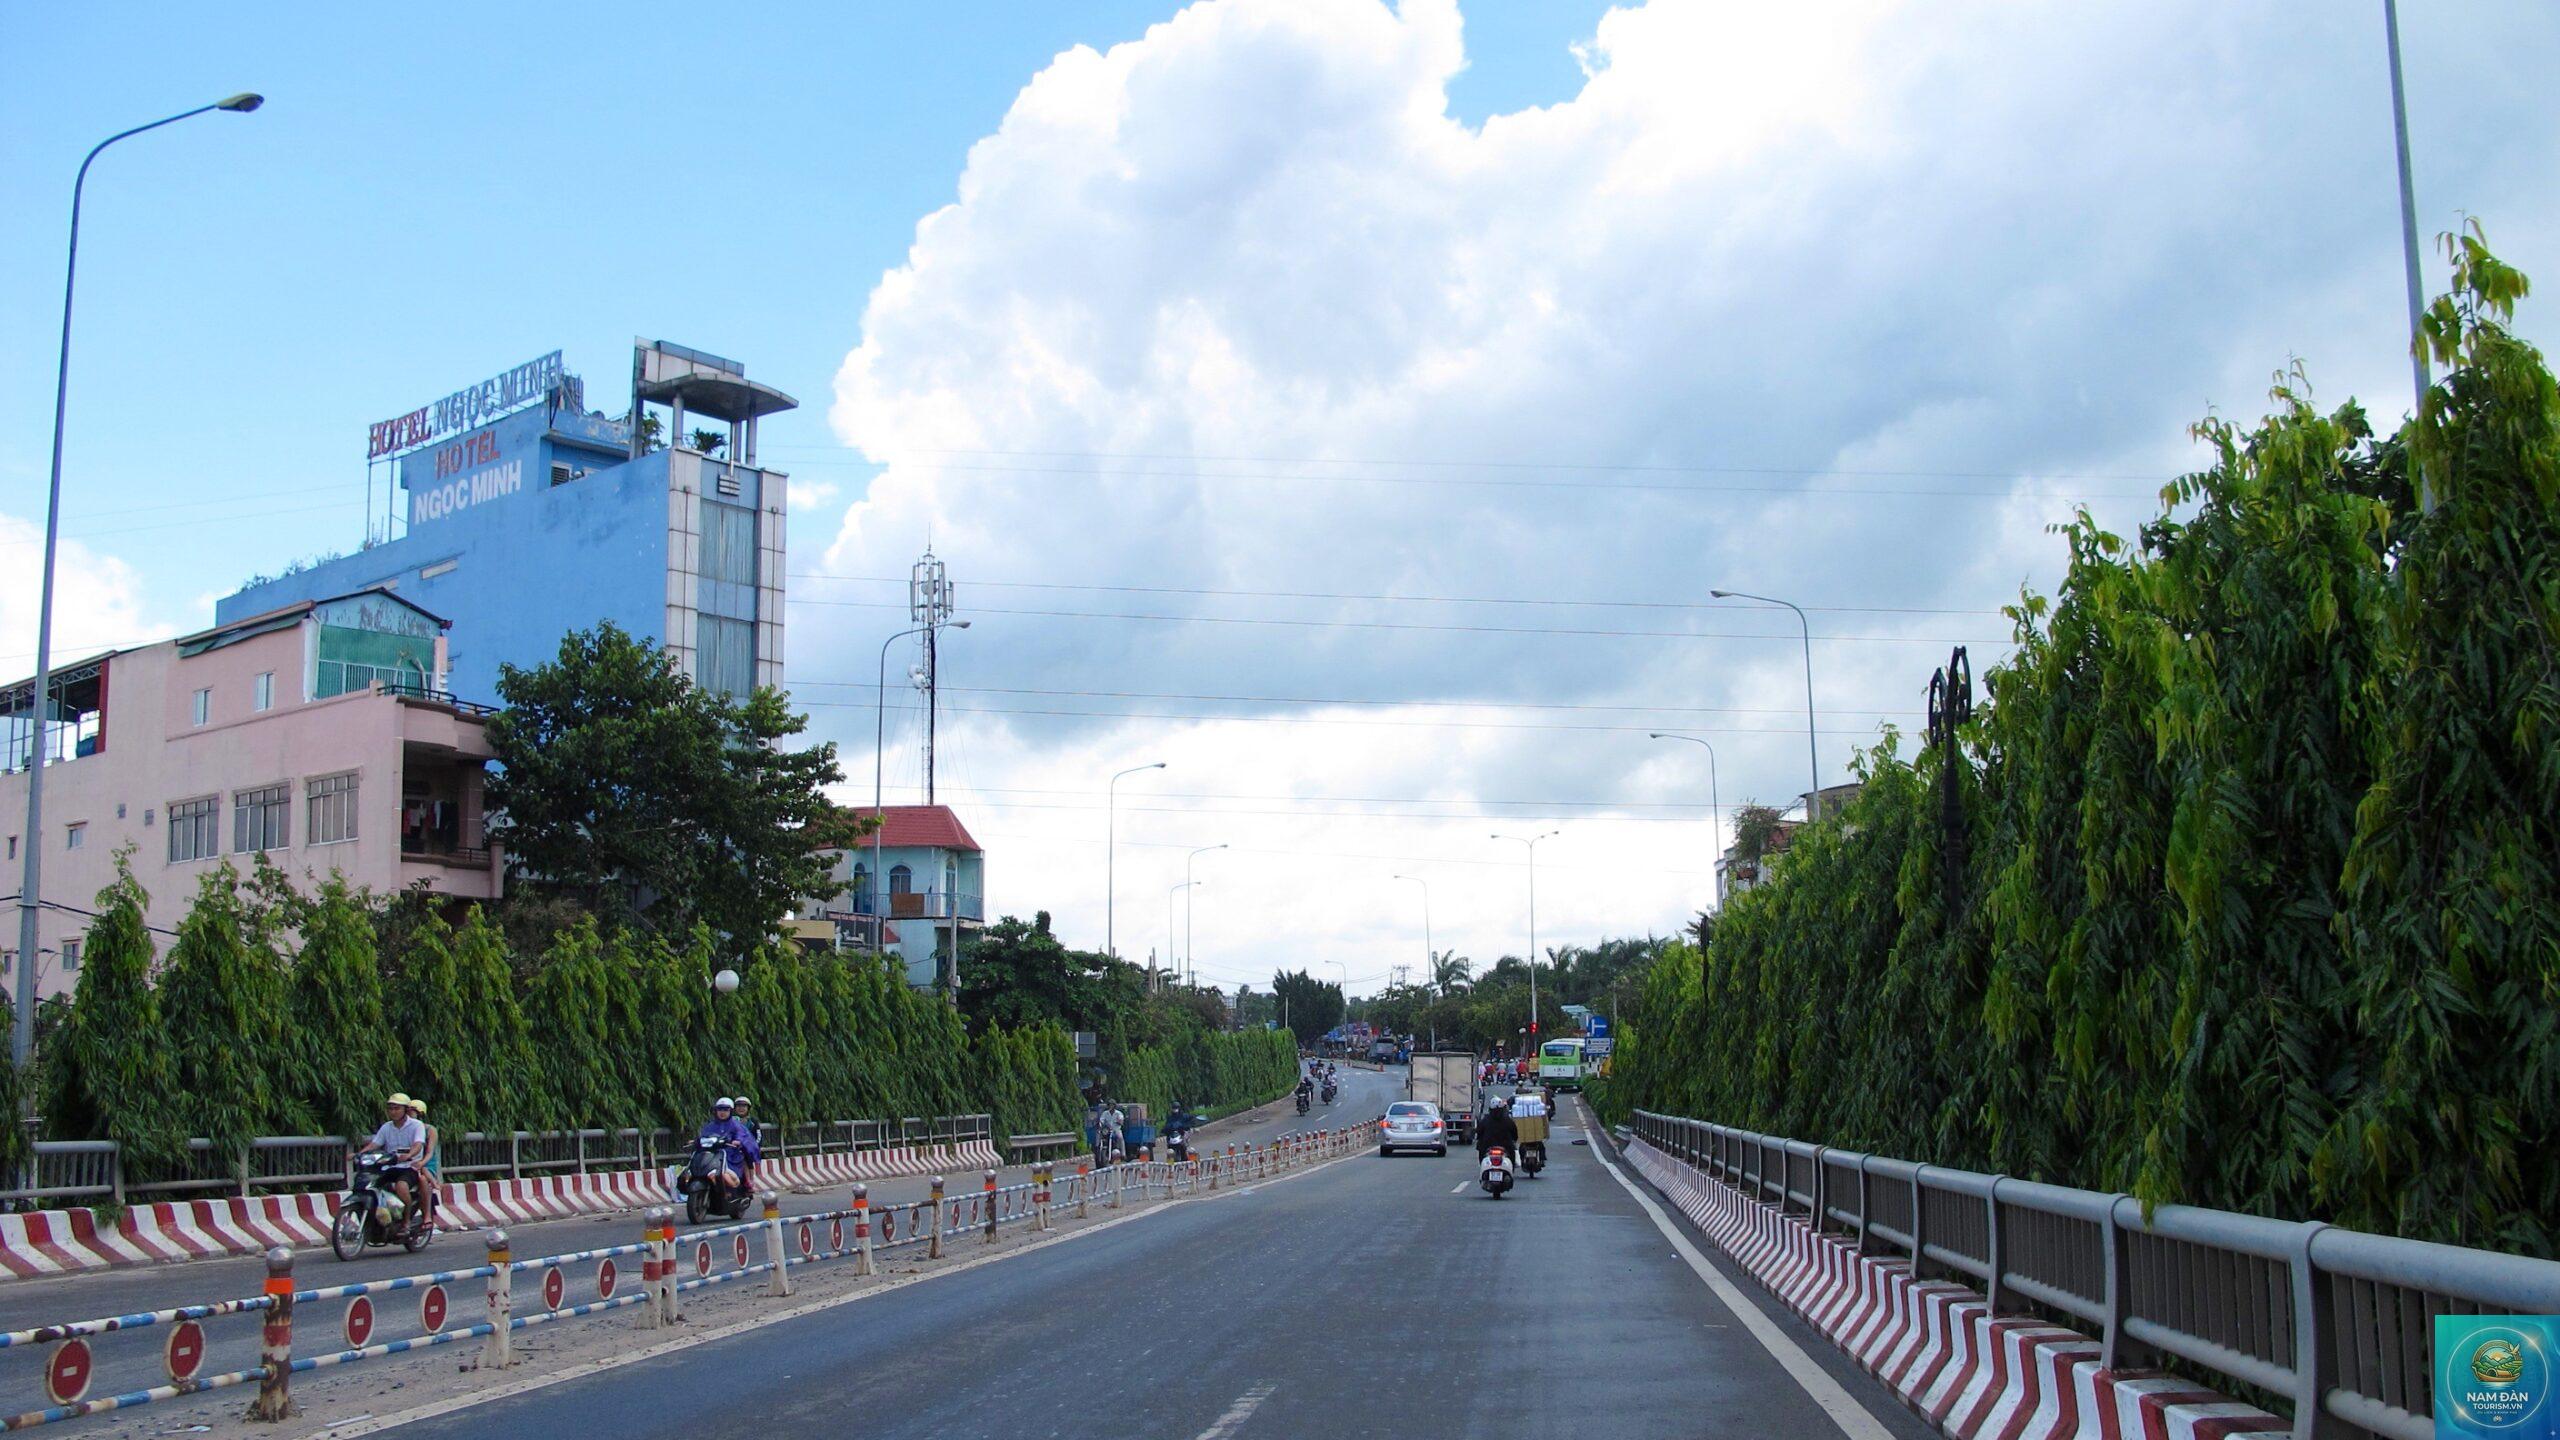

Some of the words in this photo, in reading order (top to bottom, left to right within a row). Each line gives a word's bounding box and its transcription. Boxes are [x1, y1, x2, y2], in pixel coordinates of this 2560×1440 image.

[368, 407, 432, 459] HOTEL
[498, 349, 563, 410] MINH
[436, 430, 501, 480] HOTEL
[414, 478, 469, 525] NGỌC
[471, 459, 522, 506] MINH
